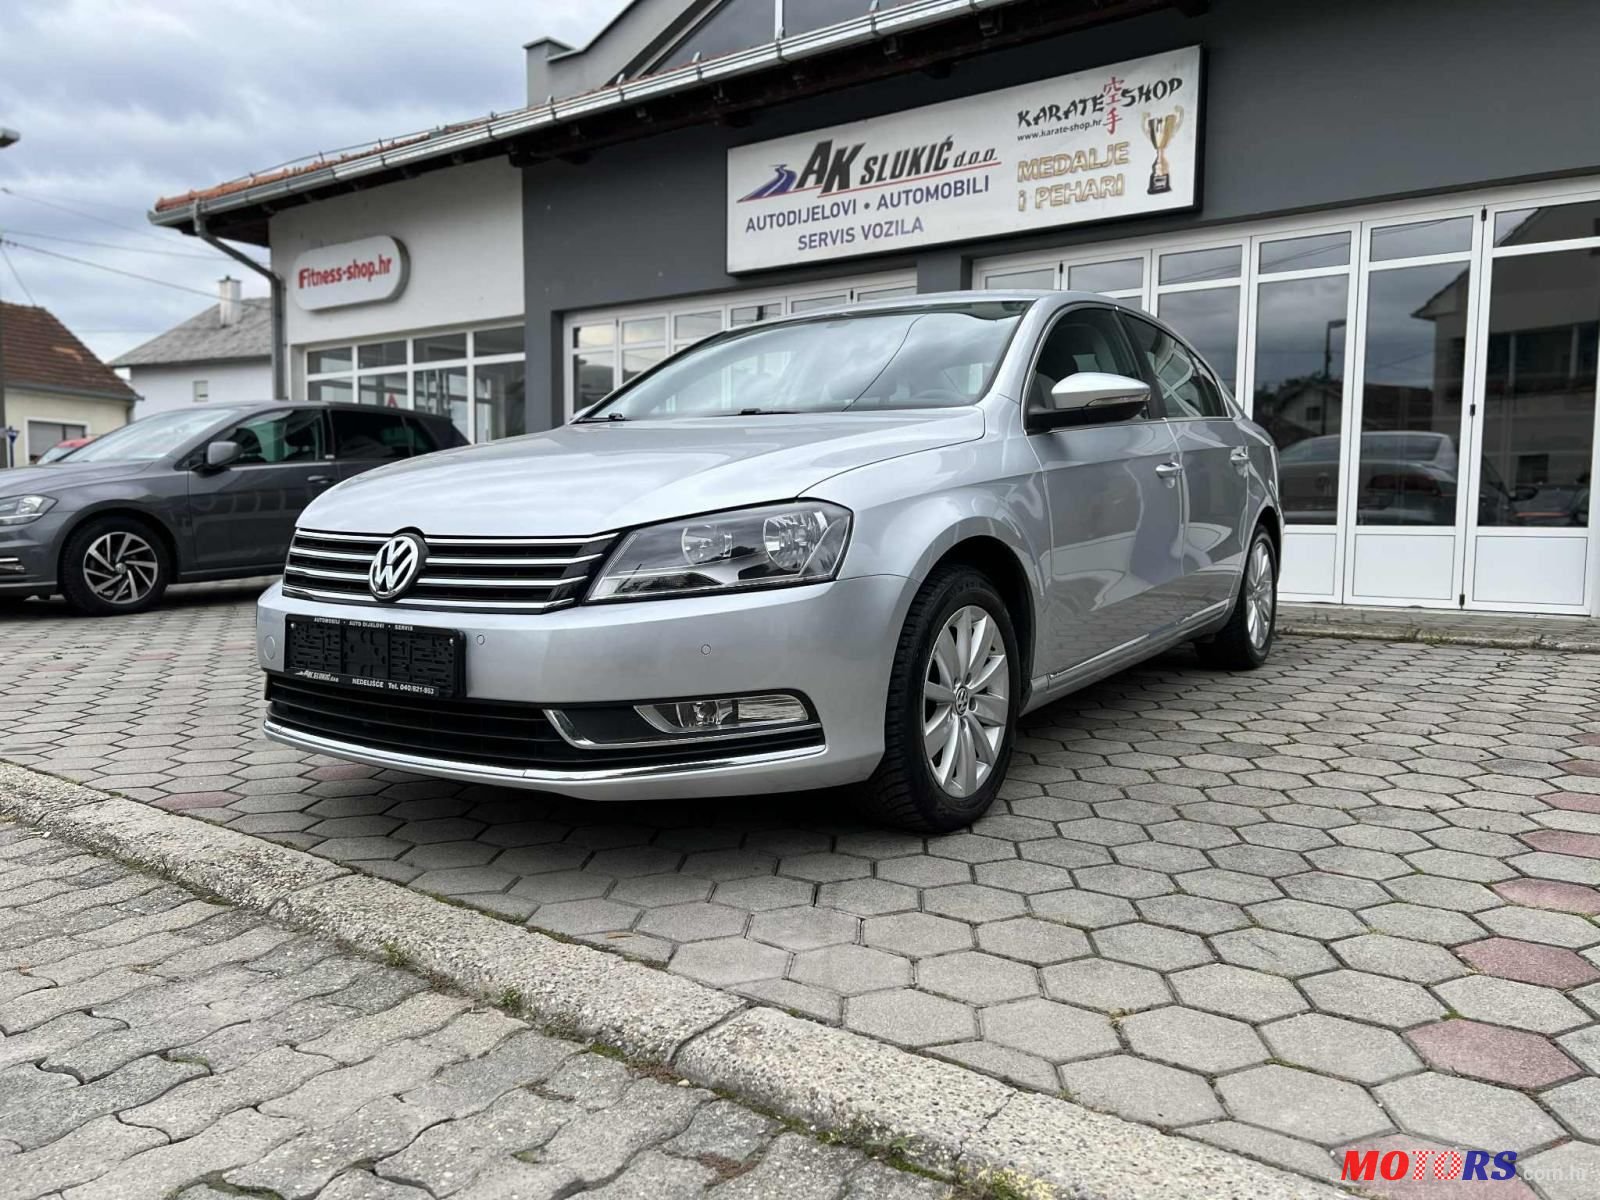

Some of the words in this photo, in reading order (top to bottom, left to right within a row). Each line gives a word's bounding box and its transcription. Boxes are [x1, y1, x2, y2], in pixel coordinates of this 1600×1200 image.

[1017, 93, 1105, 128] KARATE
[1120, 77, 1183, 107] SHOP
[1103, 76, 1125, 135] 空手
[1017, 118, 1103, 141] www.karate-shop.hr
[796, 138, 866, 194] AK
[859, 136, 954, 185] SLUKIĆ
[953, 148, 998, 168] d.o.o.
[1017, 141, 1130, 183] MEDALJE
[745, 199, 857, 233] AUTODIJELOVI
[876, 174, 990, 211] AUTOMOBILI
[1018, 190, 1027, 212] i
[1035, 173, 1126, 209] PEHARI
[797, 226, 856, 251] SERVIS
[861, 216, 924, 241] VOZILA
[298, 253, 392, 289] Fitness-shop.hr
